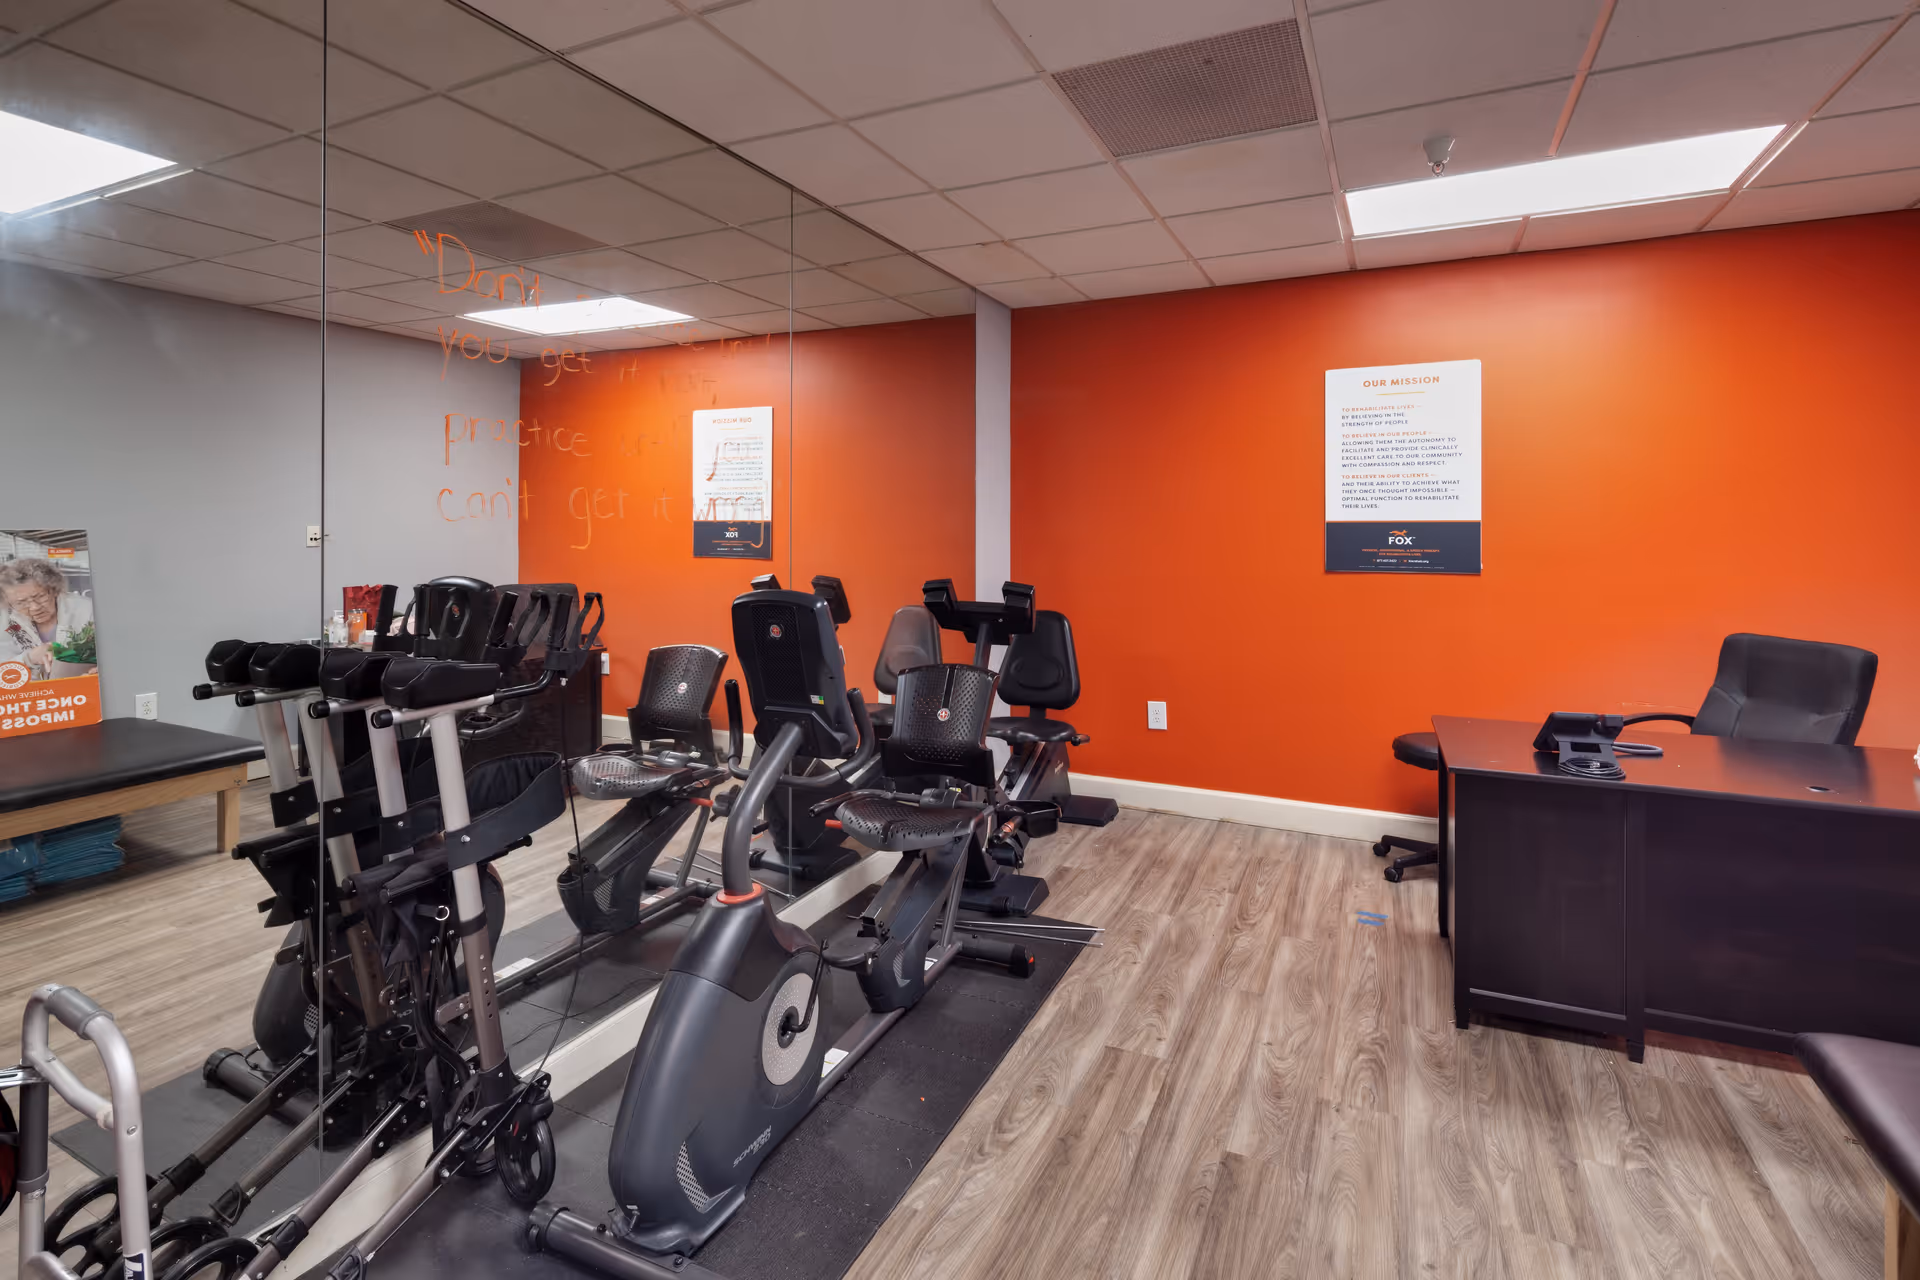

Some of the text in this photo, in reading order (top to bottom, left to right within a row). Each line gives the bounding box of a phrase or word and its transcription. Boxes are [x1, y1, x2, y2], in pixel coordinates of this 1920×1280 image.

[437, 325, 510, 381] you
[540, 347, 594, 387] get
[1363, 376, 1440, 388] OUR MISSION
[445, 413, 592, 466] practice
[437, 477, 536, 522] can't
[568, 487, 630, 549] get
[733, 1124, 771, 1168] SCHWINN
